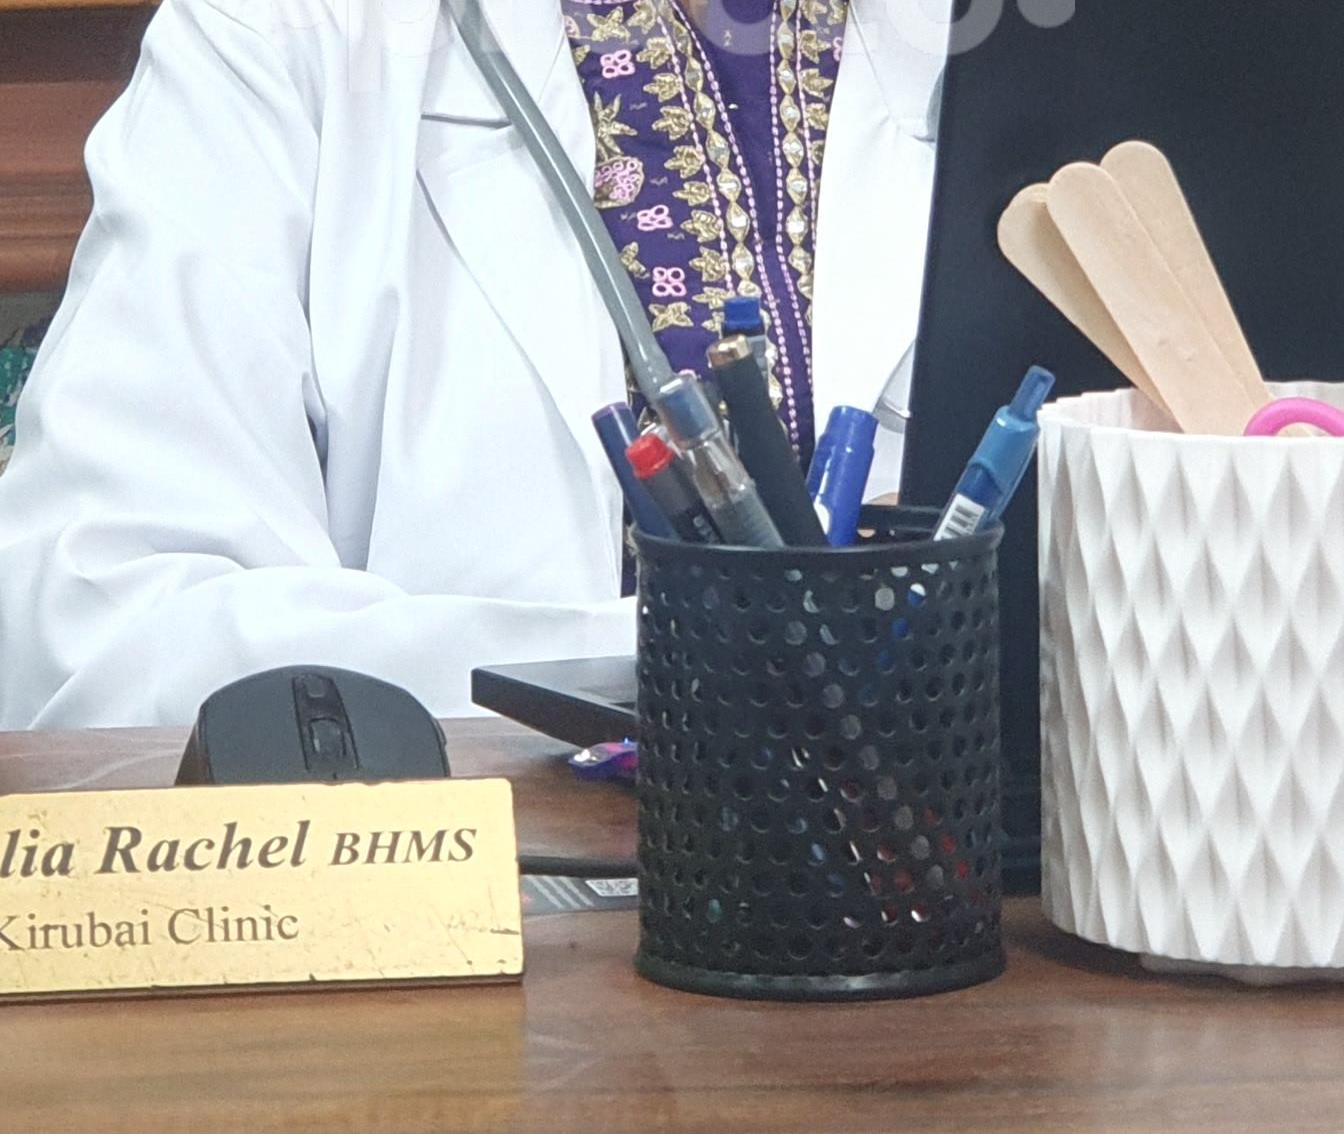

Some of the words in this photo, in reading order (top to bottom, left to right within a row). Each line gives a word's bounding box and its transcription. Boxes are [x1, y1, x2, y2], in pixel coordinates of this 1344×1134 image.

[93, 819, 312, 875] Rachel
[327, 827, 478, 866] BHMS
[167, 903, 301, 945] Clinic
